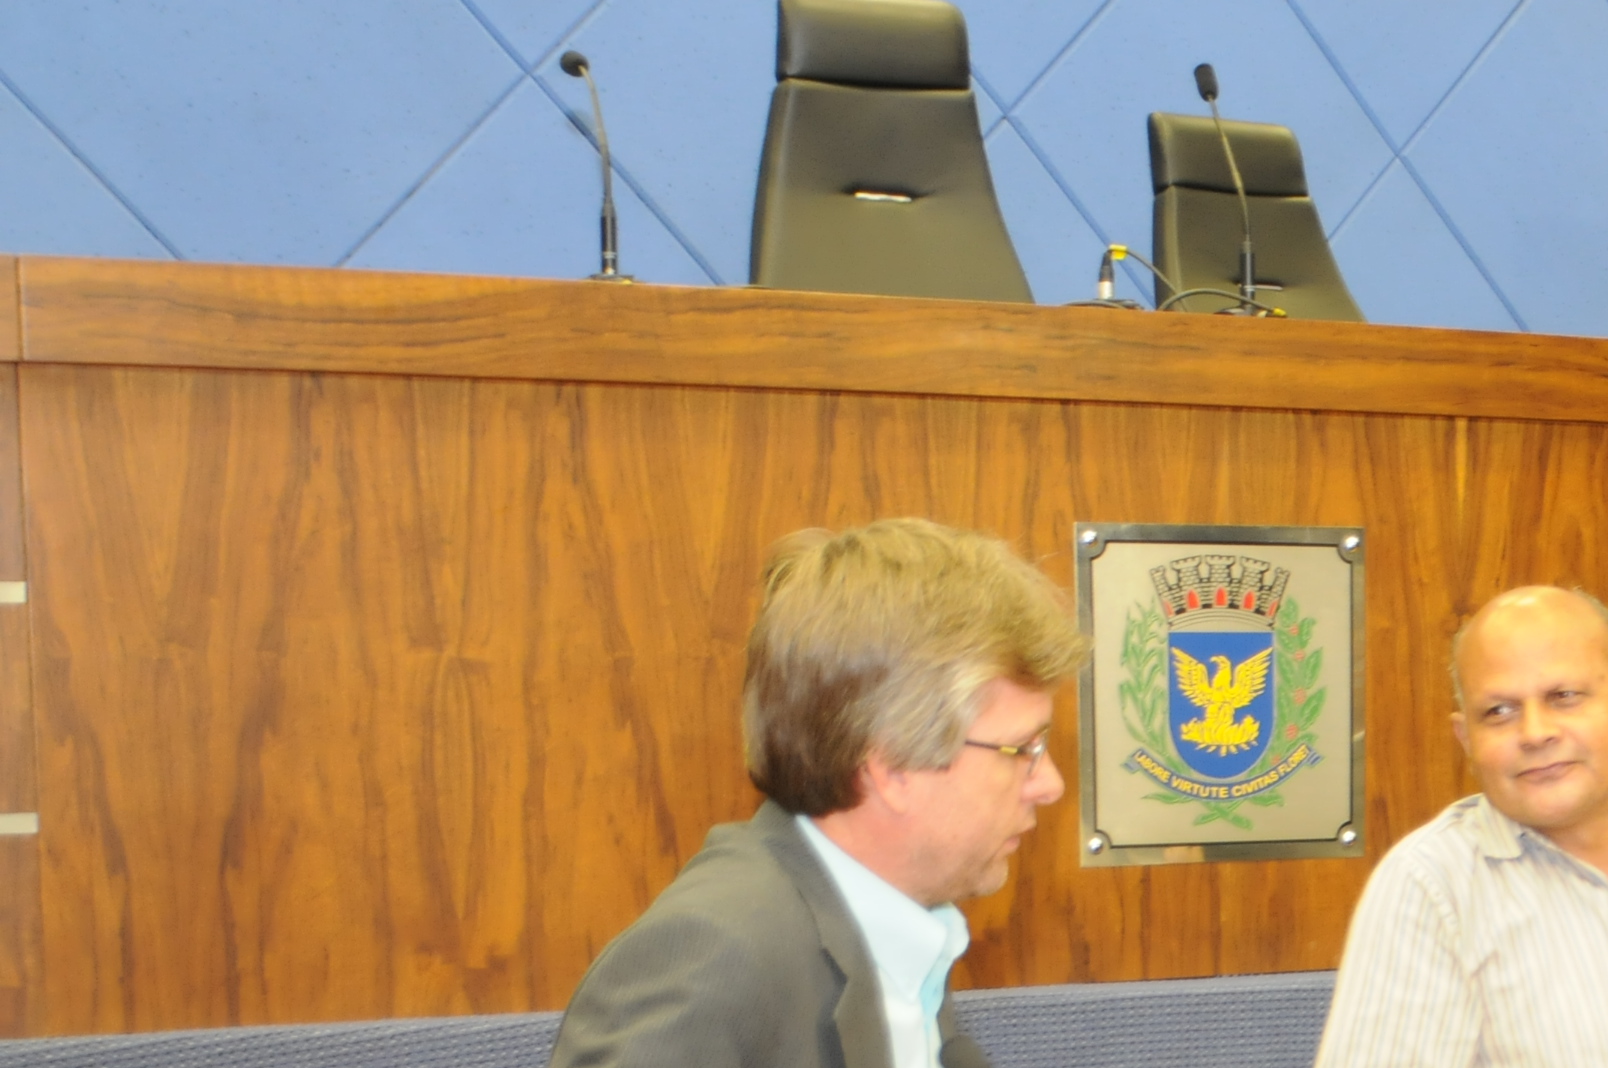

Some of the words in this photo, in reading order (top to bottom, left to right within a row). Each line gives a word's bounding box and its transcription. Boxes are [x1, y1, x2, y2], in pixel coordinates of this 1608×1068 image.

[1133, 751, 1171, 782] LABORE
[1171, 776, 1229, 798] VIRTUTE
[1231, 773, 1280, 797] CIVITAS
[1278, 744, 1311, 776] FLORET
